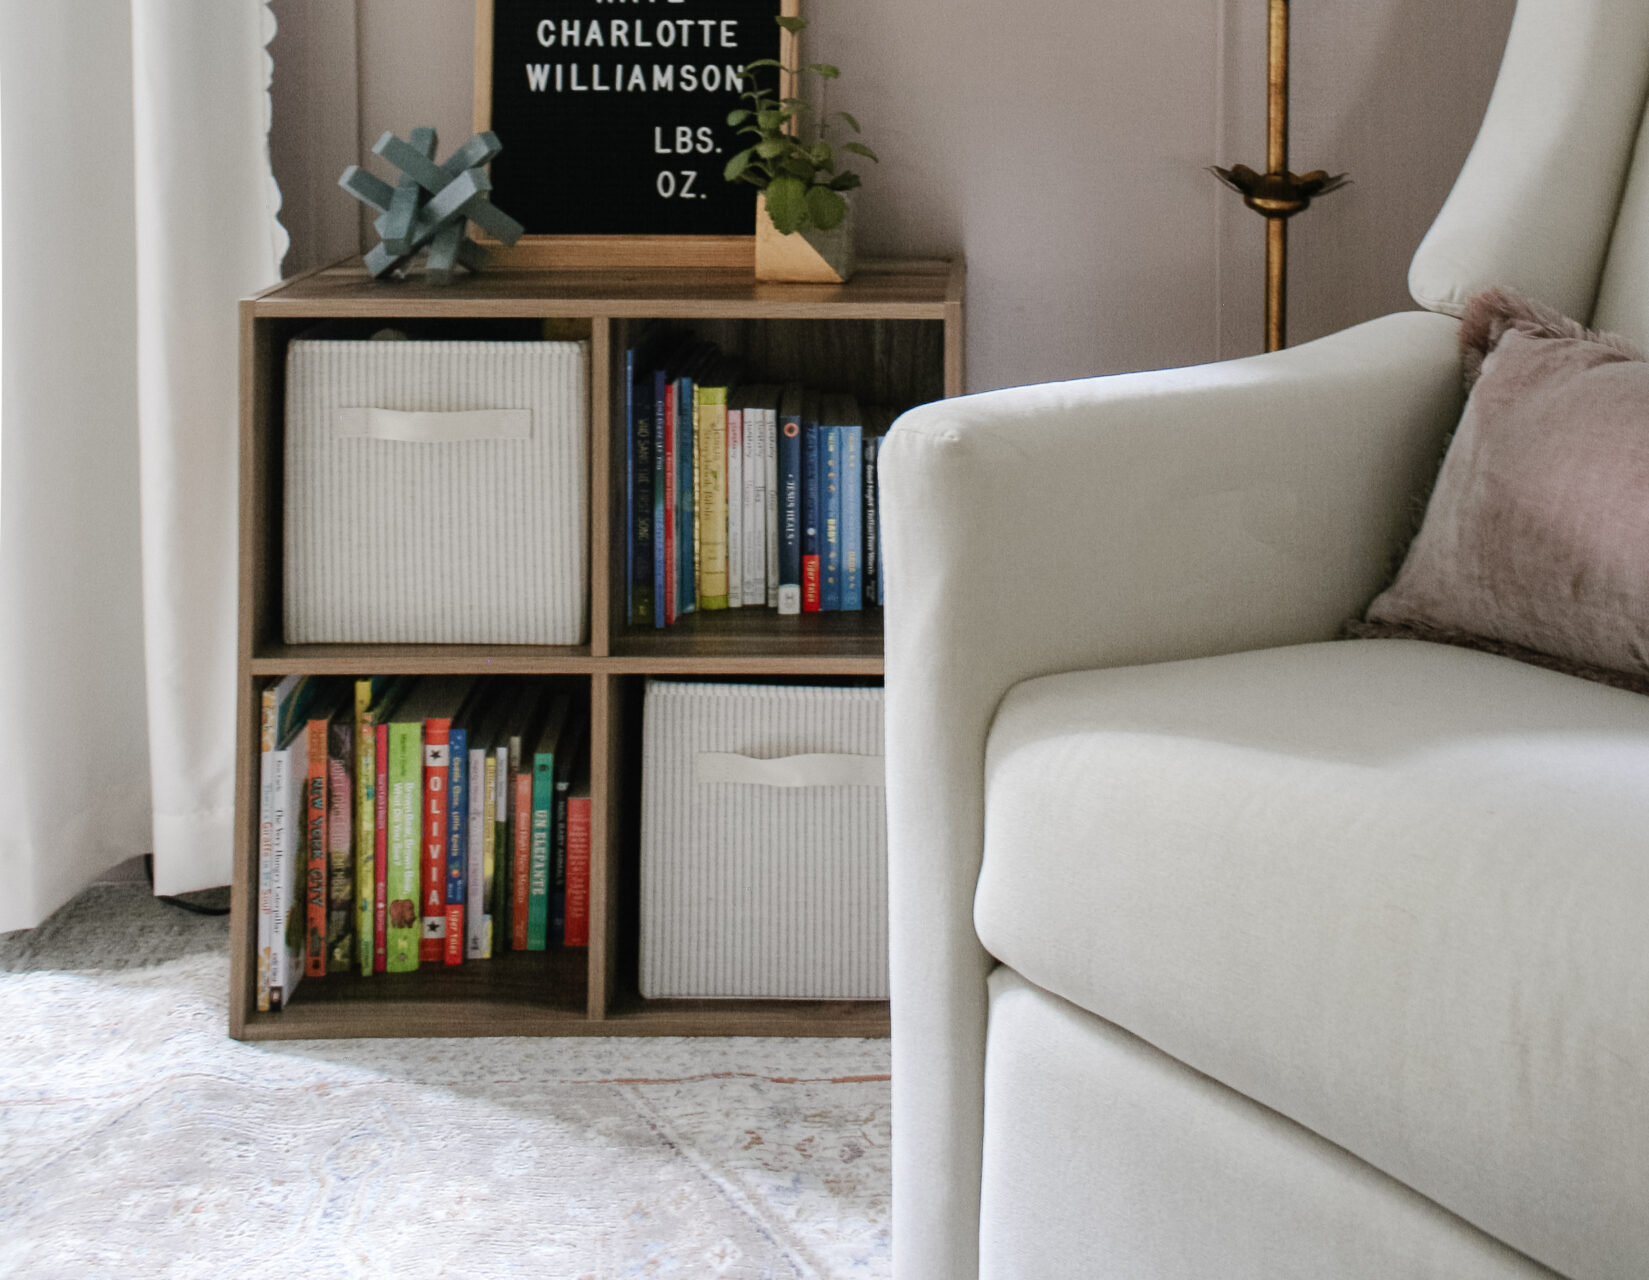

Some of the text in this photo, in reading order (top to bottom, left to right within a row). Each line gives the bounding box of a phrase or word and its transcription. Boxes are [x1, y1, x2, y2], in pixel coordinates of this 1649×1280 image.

[536, 19, 738, 47] CHARLOTTE
[525, 63, 744, 93] WILLIAMSON
[653, 126, 722, 154] LBS.
[656, 170, 707, 199] OZ.
[786, 481, 795, 539] JESUS HEALS
[827, 518, 836, 544] BABY
[311, 776, 324, 809] NEW
[393, 782, 403, 801] What
[404, 782, 414, 812] Brown
[310, 816, 324, 859] YORK
[393, 823, 402, 841] You
[429, 776, 441, 906] OLIVIA
[403, 838, 413, 869] Brown
[532, 810, 548, 896] UN ELEFANTE
[309, 868, 323, 907] CITY
